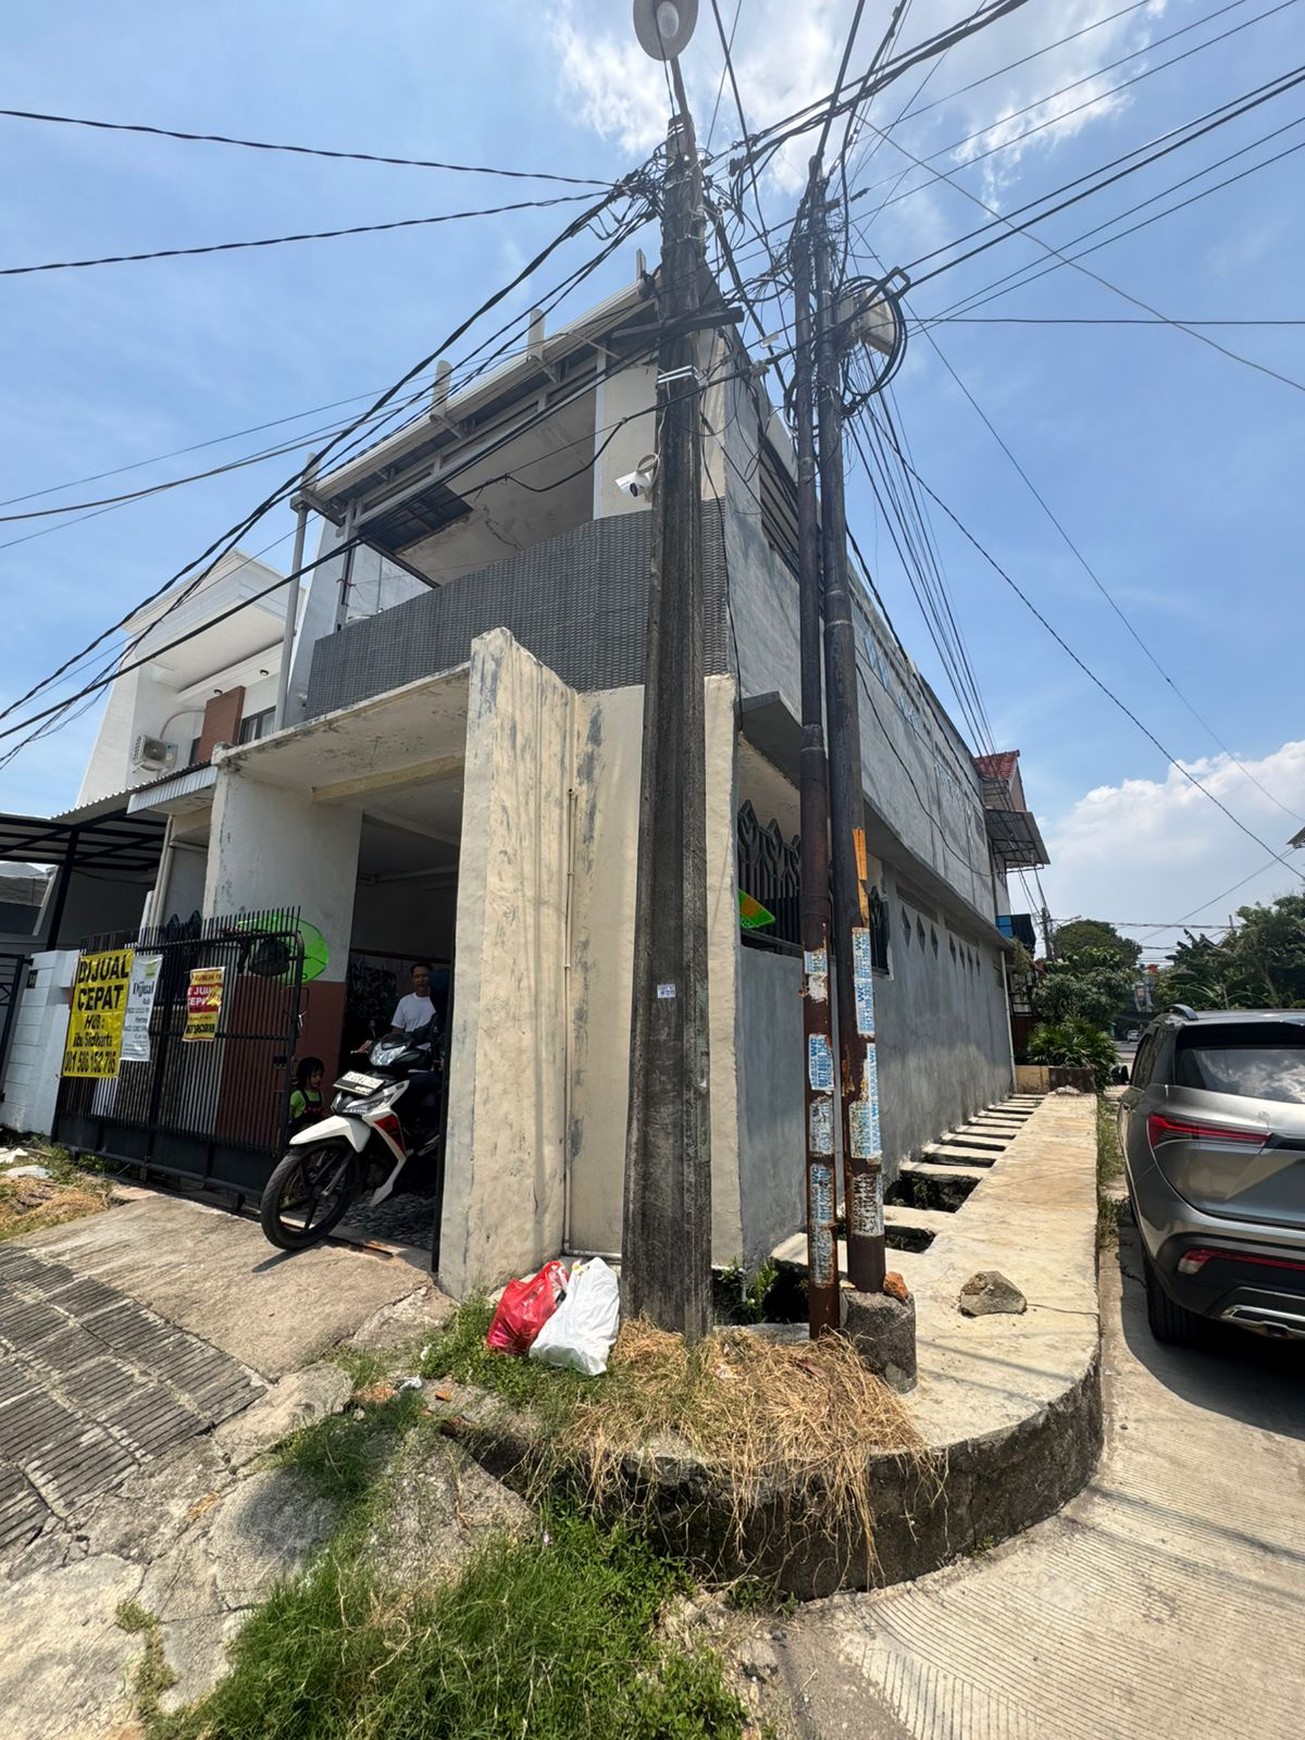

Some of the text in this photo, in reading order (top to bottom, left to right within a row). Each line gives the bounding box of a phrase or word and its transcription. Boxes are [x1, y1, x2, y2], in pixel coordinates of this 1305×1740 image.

[77, 954, 129, 984] DIJUAL
[77, 984, 124, 1012] CEPAT
[810, 1038, 817, 1057] WC
